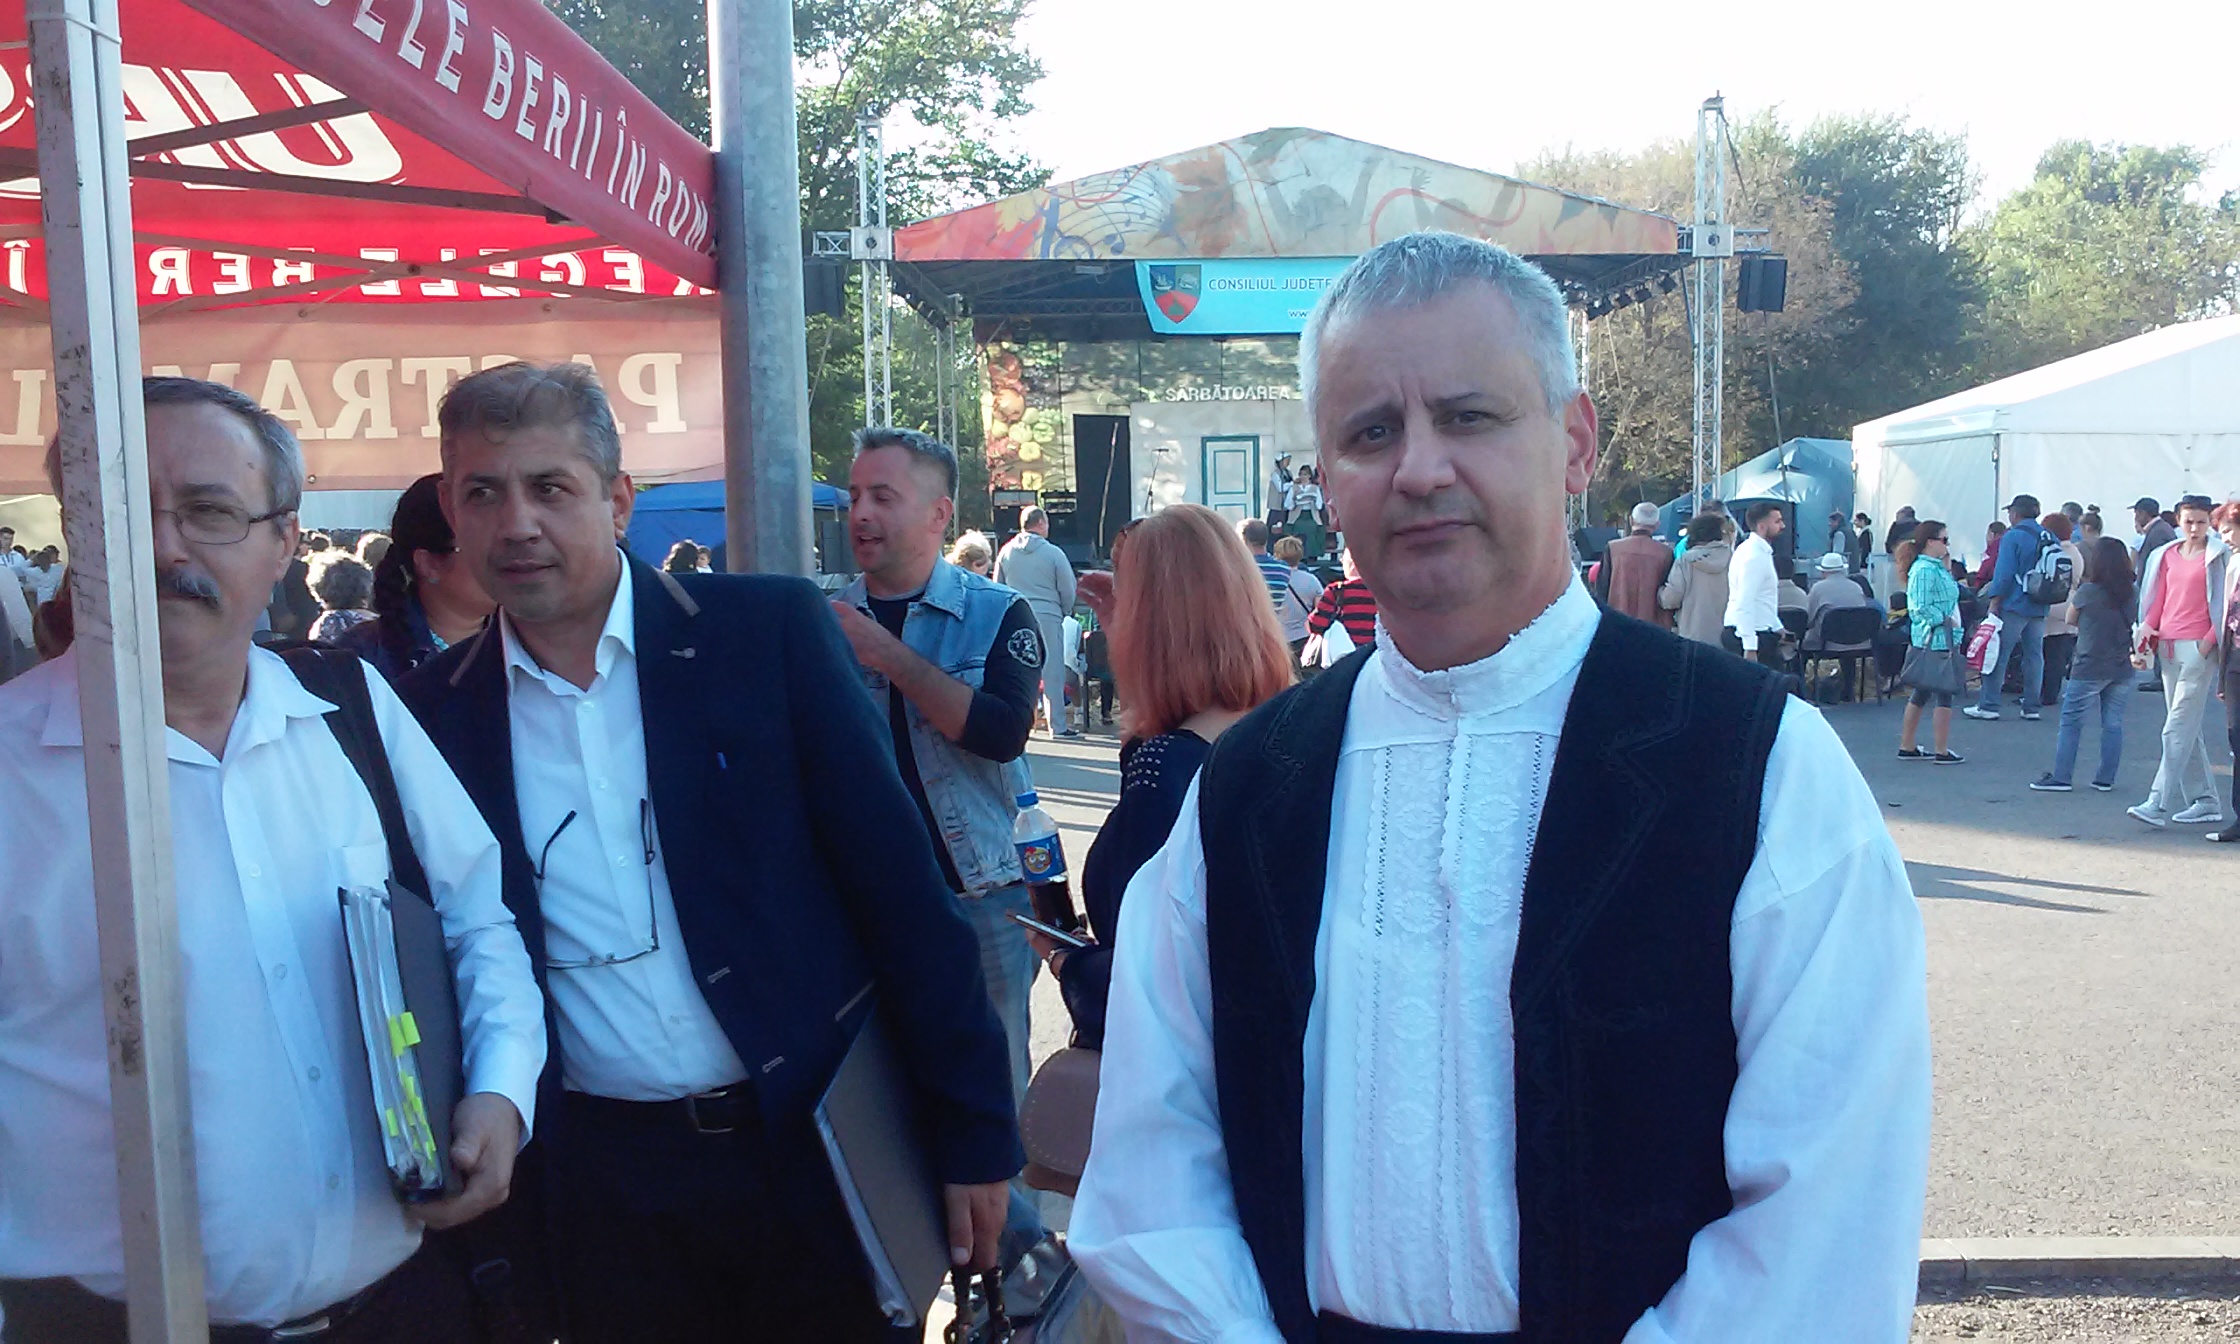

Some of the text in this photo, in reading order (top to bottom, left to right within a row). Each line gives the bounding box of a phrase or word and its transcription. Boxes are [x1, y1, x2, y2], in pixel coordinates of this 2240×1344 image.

[482, 26, 603, 181] BERII
[606, 106, 647, 210] ÎN
[648, 158, 716, 256] ROM
[1208, 278, 1277, 290] CONSILIUL
[1289, 310, 1310, 318] ww
[1165, 383, 1291, 402] SĂRBĂTOAREA
